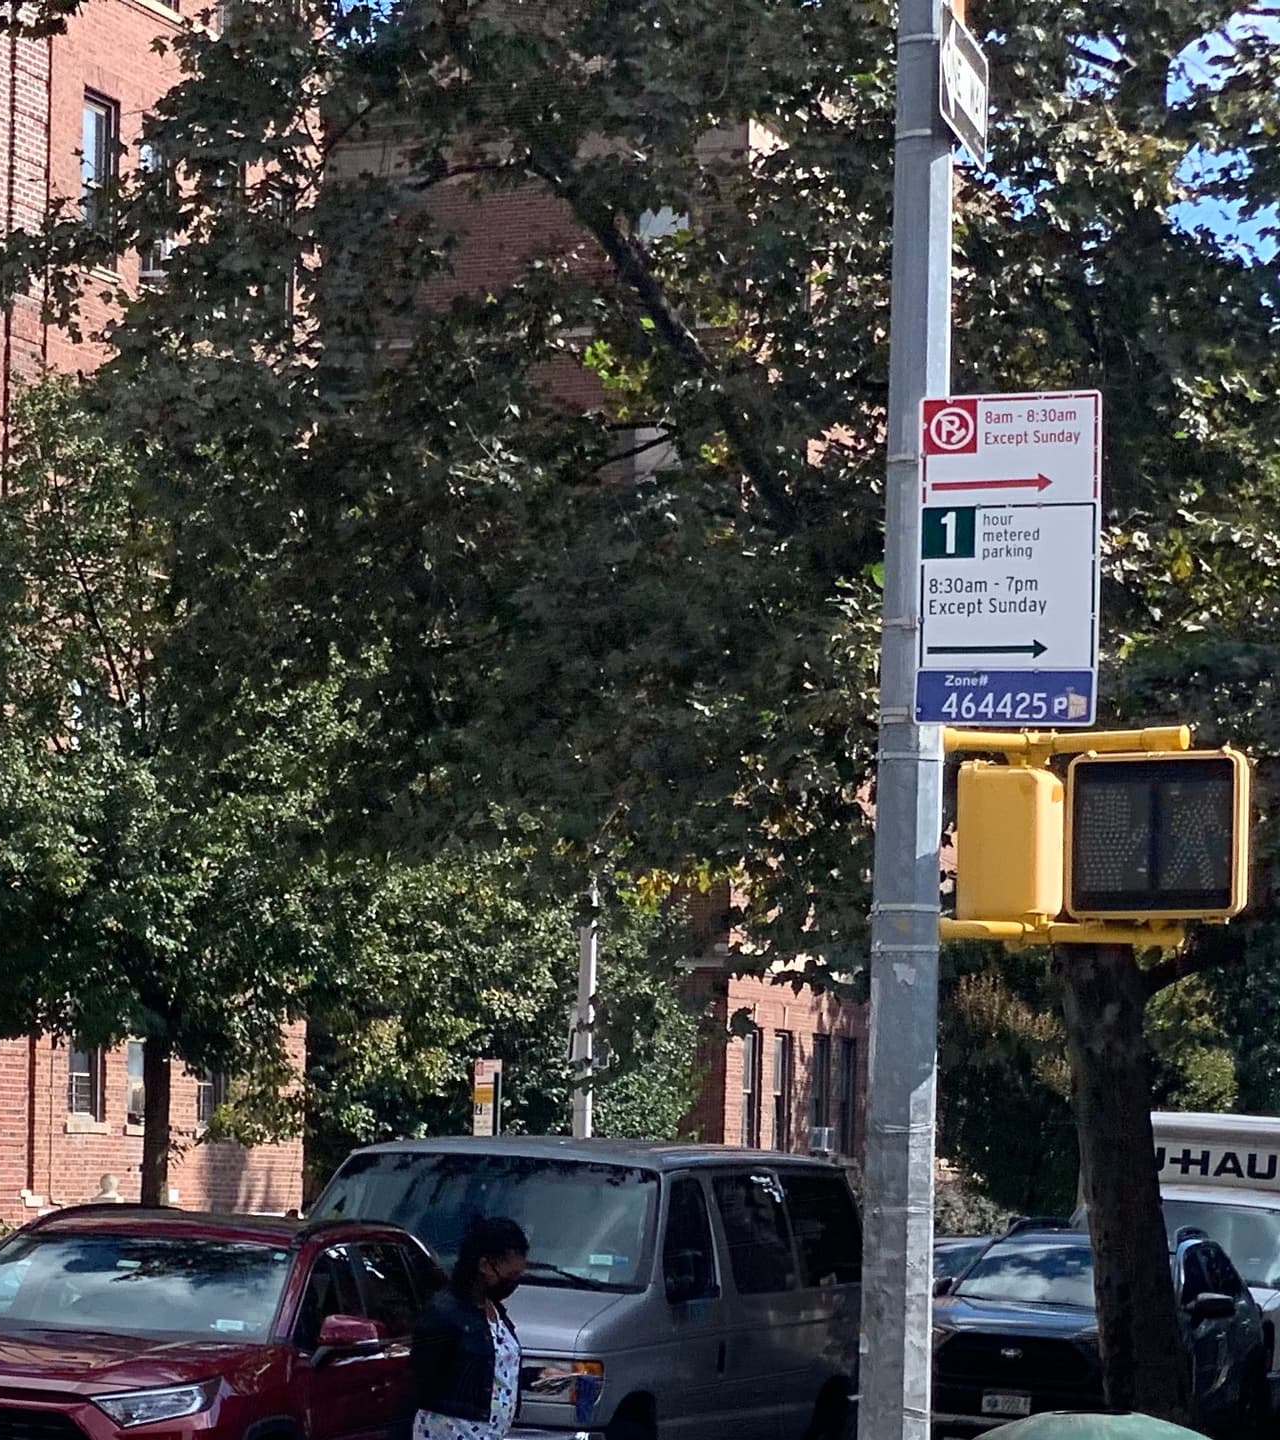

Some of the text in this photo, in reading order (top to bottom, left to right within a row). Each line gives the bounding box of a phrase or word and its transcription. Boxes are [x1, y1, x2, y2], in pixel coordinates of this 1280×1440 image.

[984, 410, 1013, 424] 8am
[1026, 409, 1077, 423] 8:30am
[984, 430, 1081, 446] Except Sunday
[983, 513, 1014, 526] hour
[941, 511, 956, 554] 1
[982, 528, 1040, 542] metered
[982, 545, 1033, 560] parking
[928, 577, 988, 594] 8:30am
[1006, 576, 1039, 595] 7pm
[928, 597, 1047, 617] Except Sunday
[944, 675, 989, 687] Zone#
[941, 692, 1047, 719] 464425
